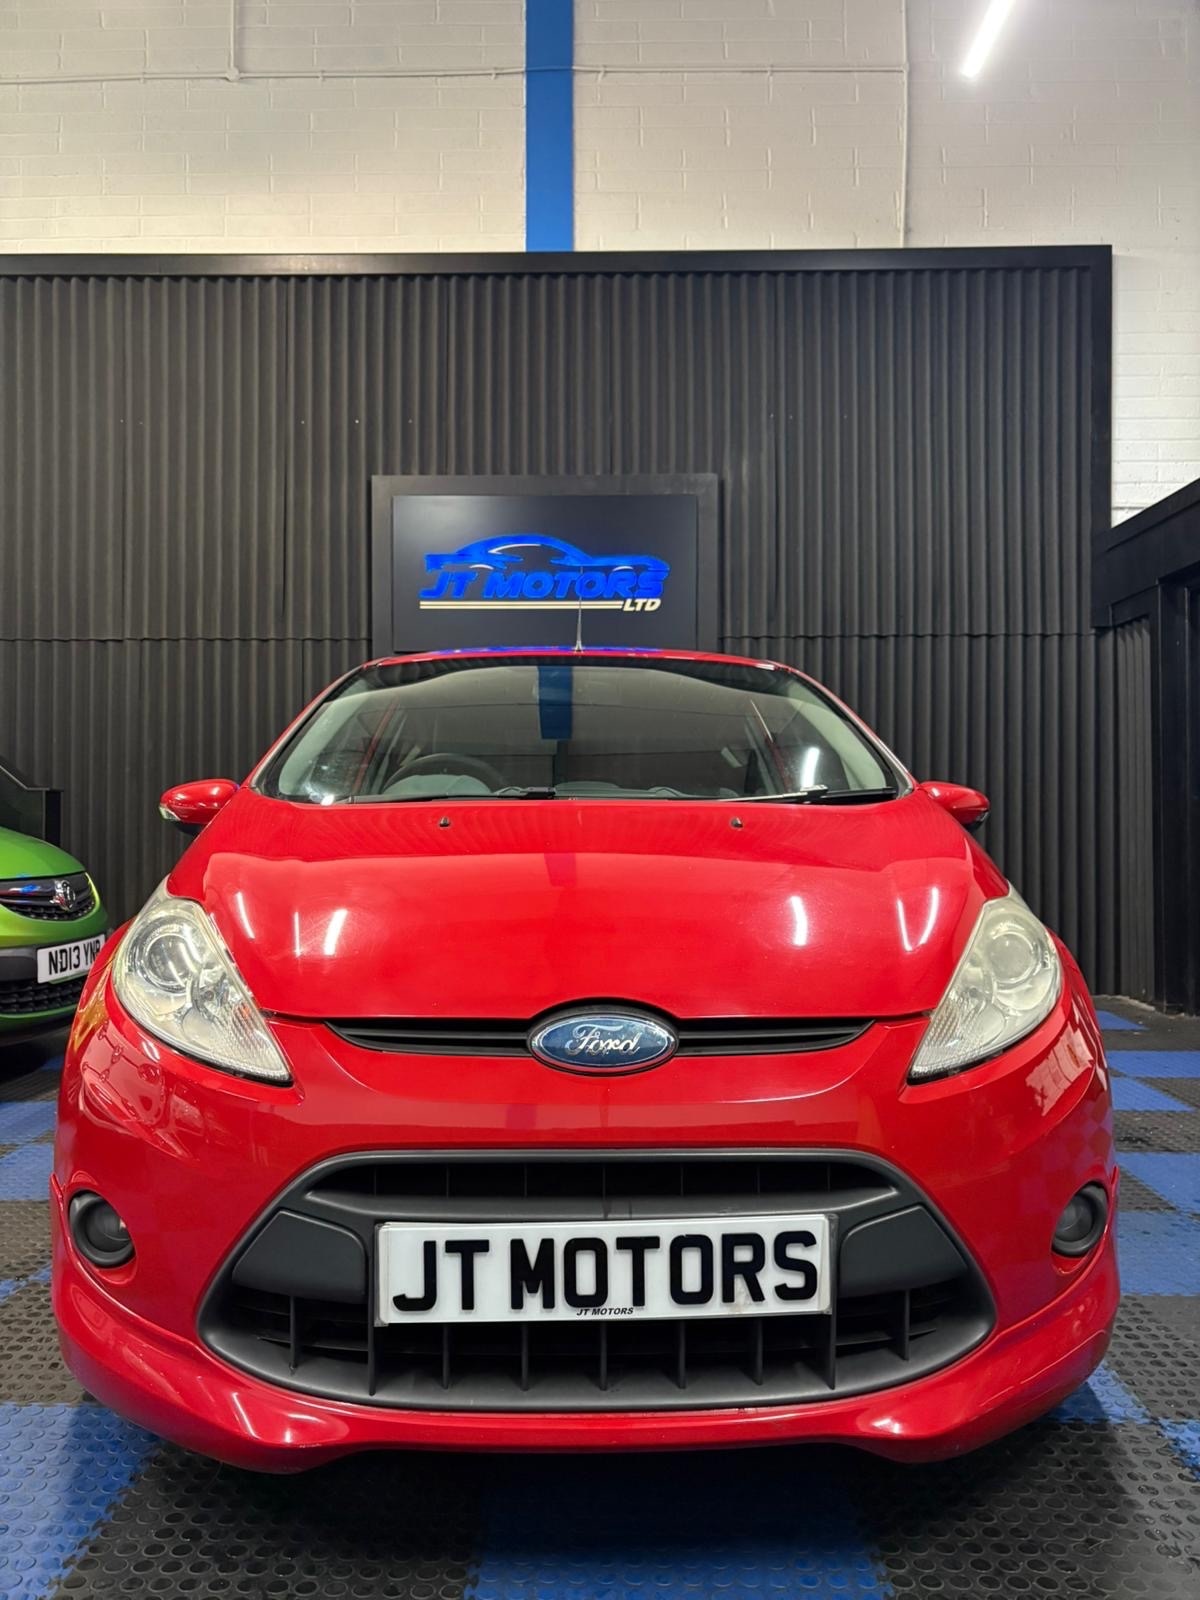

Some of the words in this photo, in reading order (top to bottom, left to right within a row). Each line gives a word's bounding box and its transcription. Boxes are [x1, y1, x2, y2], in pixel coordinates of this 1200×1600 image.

[419, 572, 476, 599] JT
[482, 570, 667, 599] MOTORS
[623, 598, 661, 612] LTD
[48, 946, 80, 975] ND13
[565, 1023, 641, 1056] Ford
[392, 1239, 490, 1312] JT
[510, 1230, 818, 1310] MOTORS
[576, 1308, 590, 1316] JT
[591, 1307, 634, 1316] MOTORS
